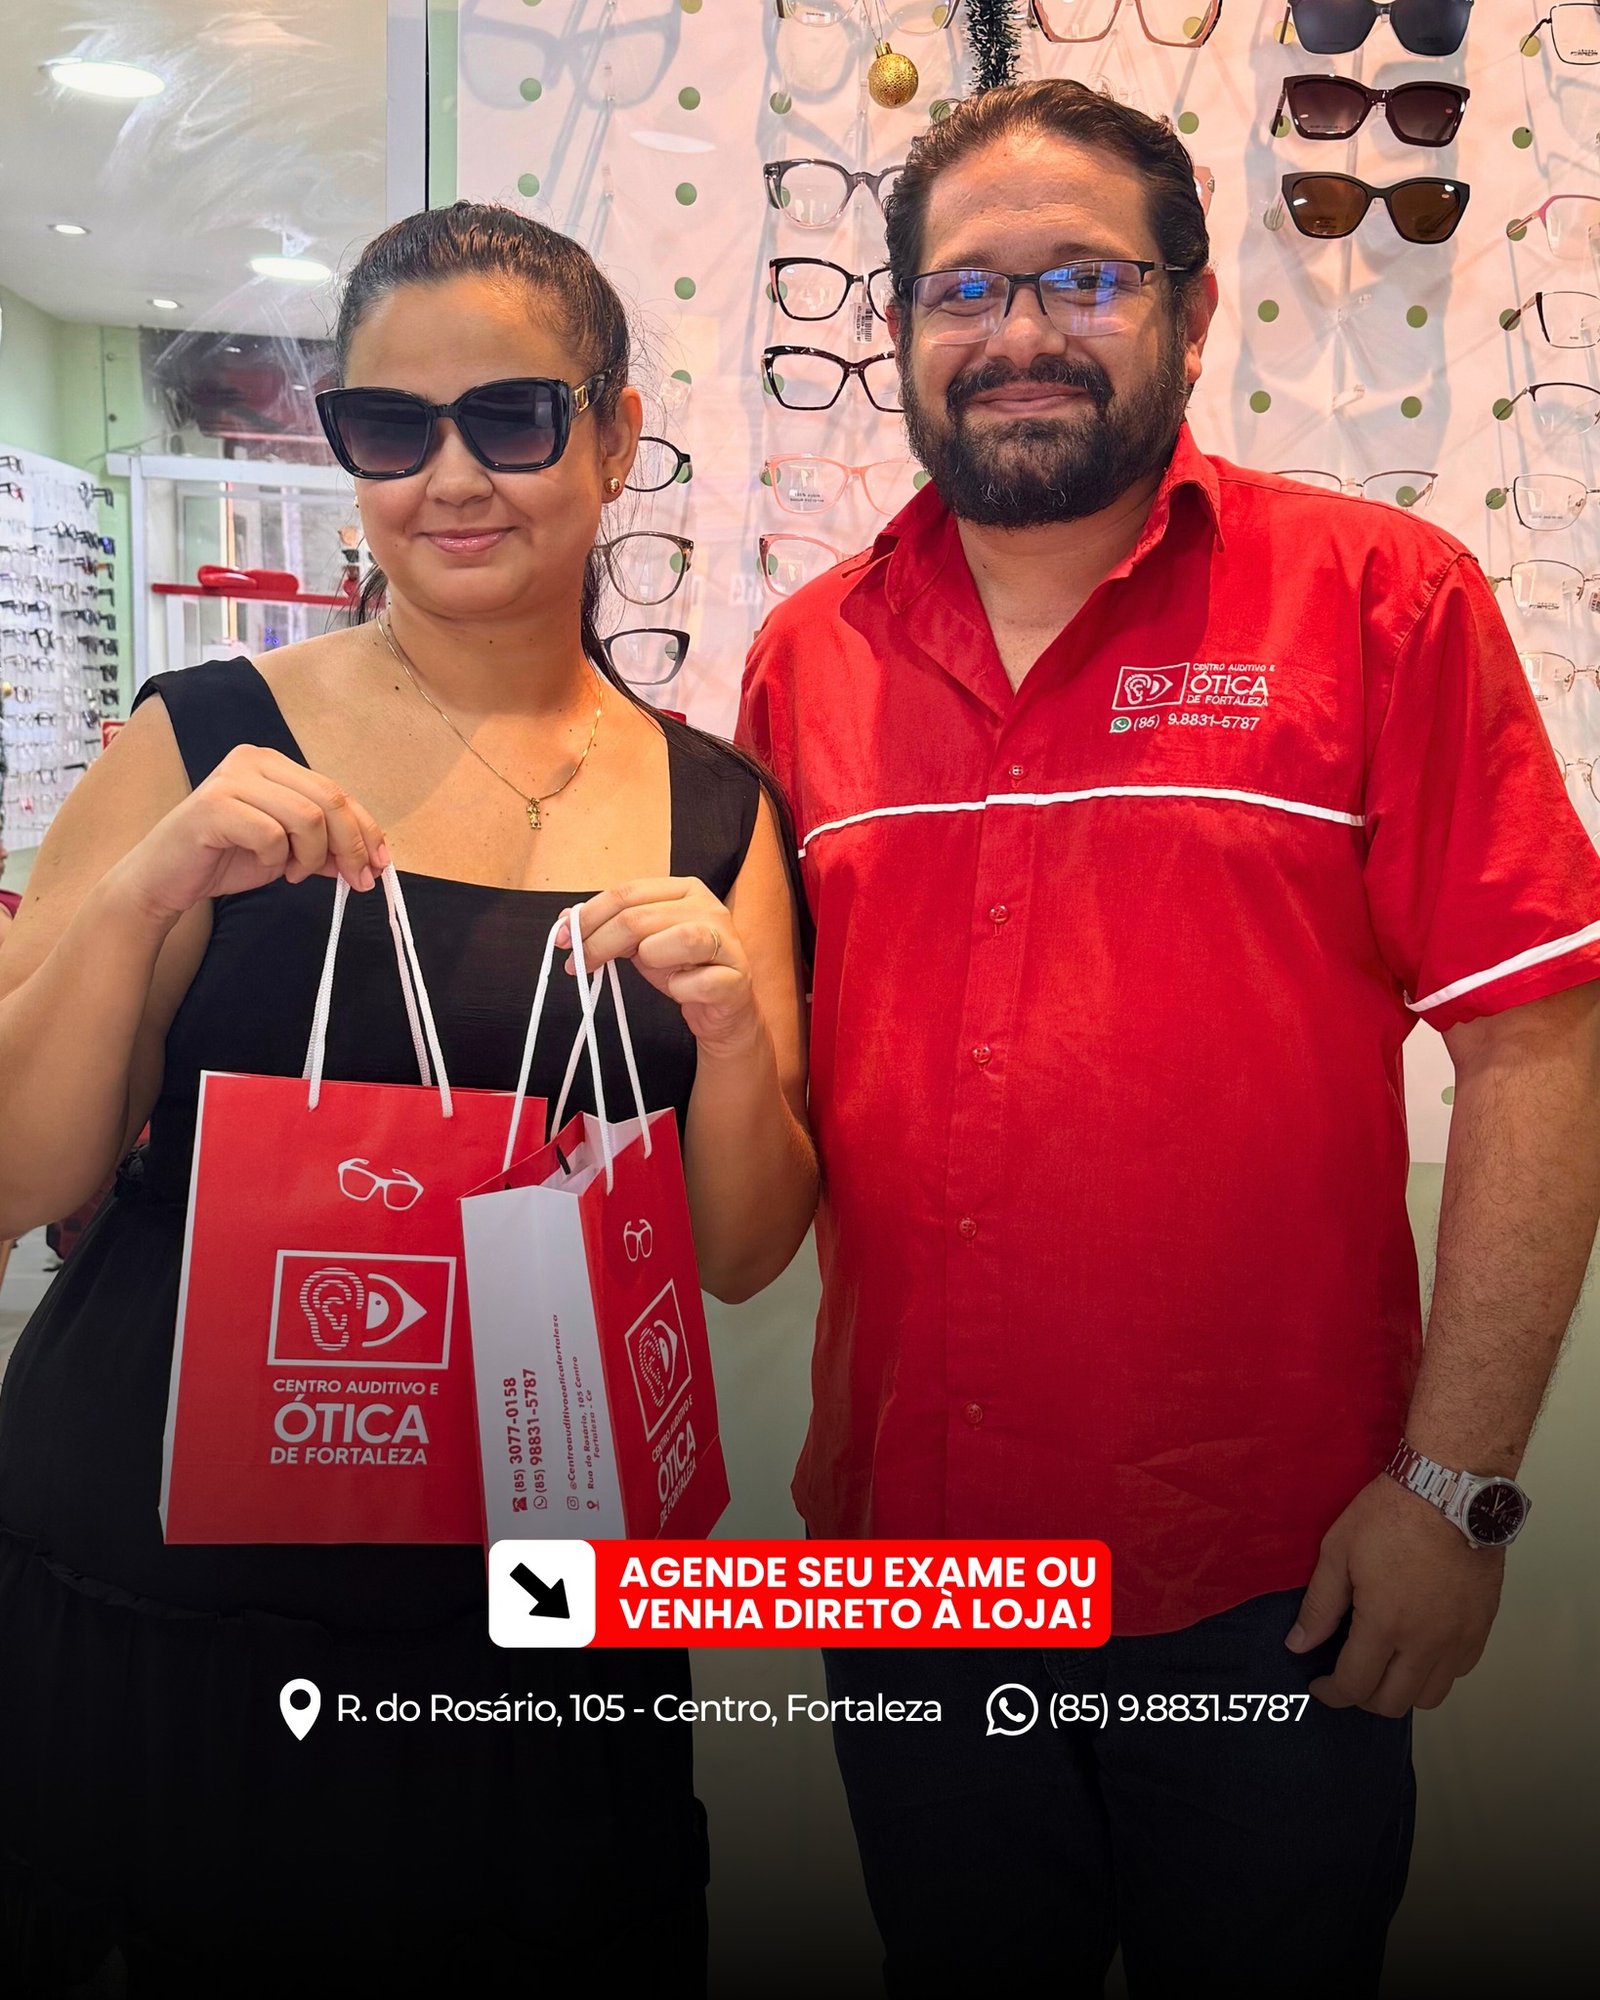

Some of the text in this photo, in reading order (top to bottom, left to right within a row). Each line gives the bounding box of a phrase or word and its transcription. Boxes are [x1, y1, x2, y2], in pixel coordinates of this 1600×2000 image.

[1193, 663, 1224, 672] CENTRO
[1228, 663, 1266, 672] AUDITIVO
[1190, 671, 1269, 696] ÓTICA
[1186, 694, 1269, 707] DE FORTALEZA
[1133, 712, 1261, 732] (85) 9.8831-5787
[572, 1356, 582, 1388] Centro
[272, 1379, 439, 1395] CENTRO AUDITIVO E
[577, 1391, 585, 1408] 105
[274, 1394, 429, 1444] ÓTICA
[523, 1368, 548, 1494] (85) 98831-5787
[652, 1429, 671, 1462] CENTRO
[670, 1399, 690, 1435] AUDITIVO
[503, 1377, 528, 1493] (85) 3077-0158
[590, 1412, 600, 1458] Fortaleza
[270, 1447, 427, 1465] DE FORTALEZA
[585, 1455, 592, 1468] do
[657, 1420, 697, 1504] ÓTICA
[659, 1456, 698, 1529] DE FORTALEZA
